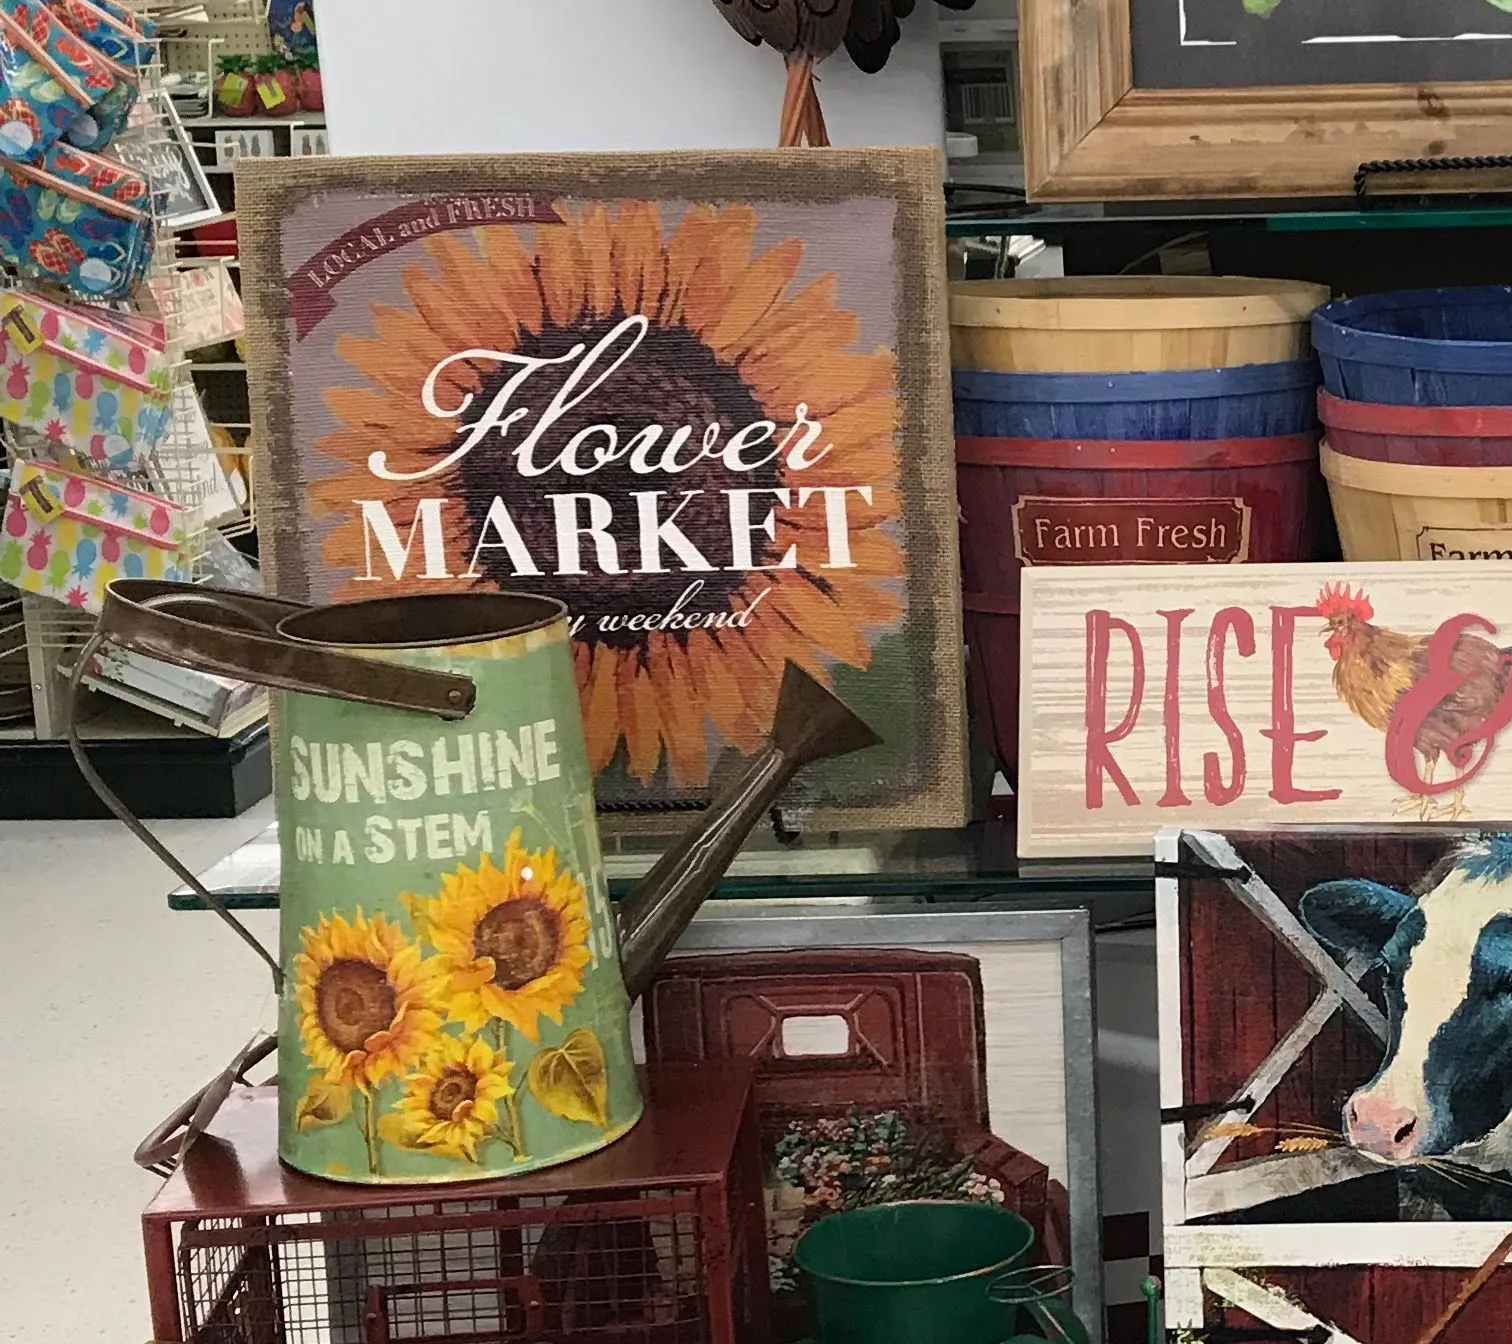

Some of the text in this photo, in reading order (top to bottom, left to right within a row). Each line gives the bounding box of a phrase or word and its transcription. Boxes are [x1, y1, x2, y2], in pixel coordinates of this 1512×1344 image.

[306, 195, 536, 288] LOCAL and FRESH
[368, 314, 833, 481] Flower
[352, 485, 874, 581] MARKET
[1034, 516, 1227, 549] Farm Fresh
[599, 579, 772, 633] weekend
[1084, 604, 1343, 810] RISE
[290, 718, 562, 805] SUNSHINE
[296, 810, 494, 866] ON A STEM
